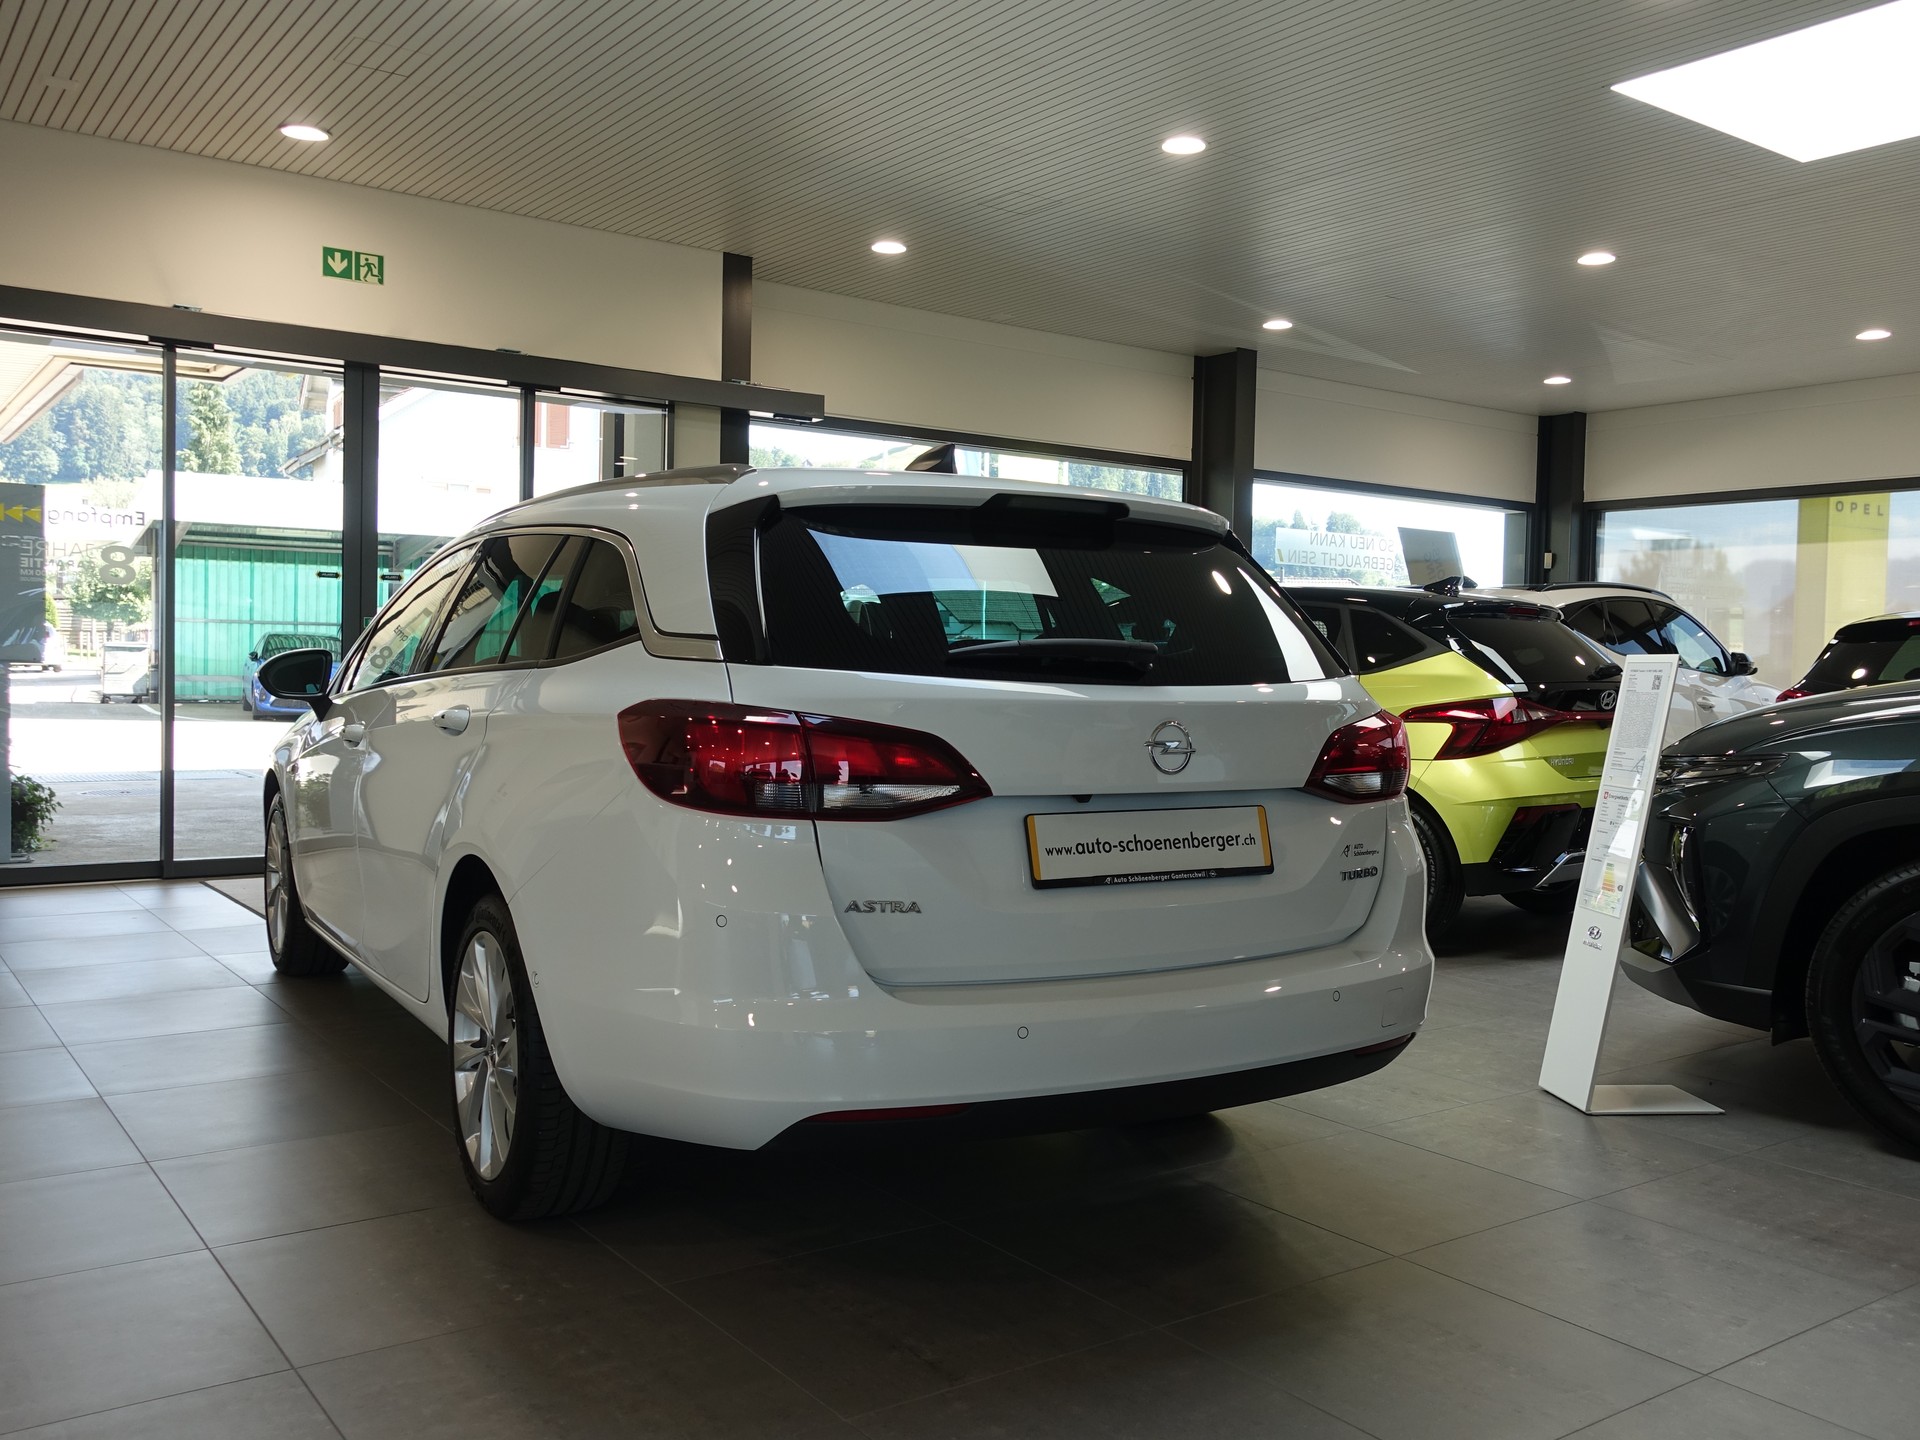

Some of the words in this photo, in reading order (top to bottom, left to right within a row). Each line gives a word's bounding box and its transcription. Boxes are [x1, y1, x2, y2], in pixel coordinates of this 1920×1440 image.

[1835, 501, 1884, 516] OPEL
[1045, 831, 1257, 857] www.auto-schoenenberger.ch
[1113, 876, 1128, 884] Auto
[1128, 874, 1170, 882] Schönenberger
[1340, 866, 1378, 881] TURBO
[844, 899, 922, 914] ASTRA
